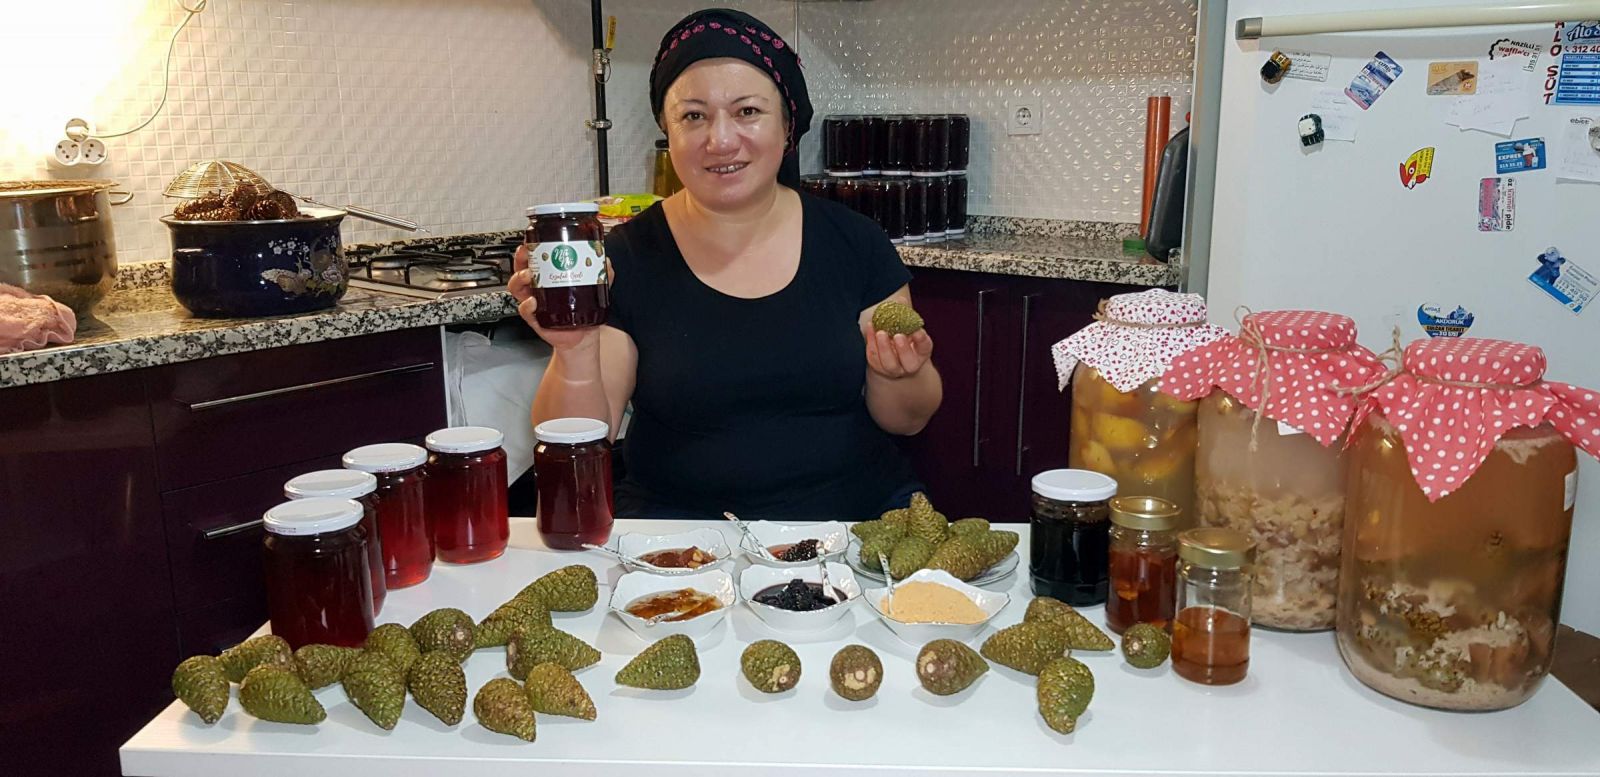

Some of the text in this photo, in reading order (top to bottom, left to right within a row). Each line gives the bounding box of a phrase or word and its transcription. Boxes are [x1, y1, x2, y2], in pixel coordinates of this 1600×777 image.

[1567, 24, 1592, 41] Alo
[1572, 45, 1588, 53] 312
[1543, 64, 1559, 105] SÜT
